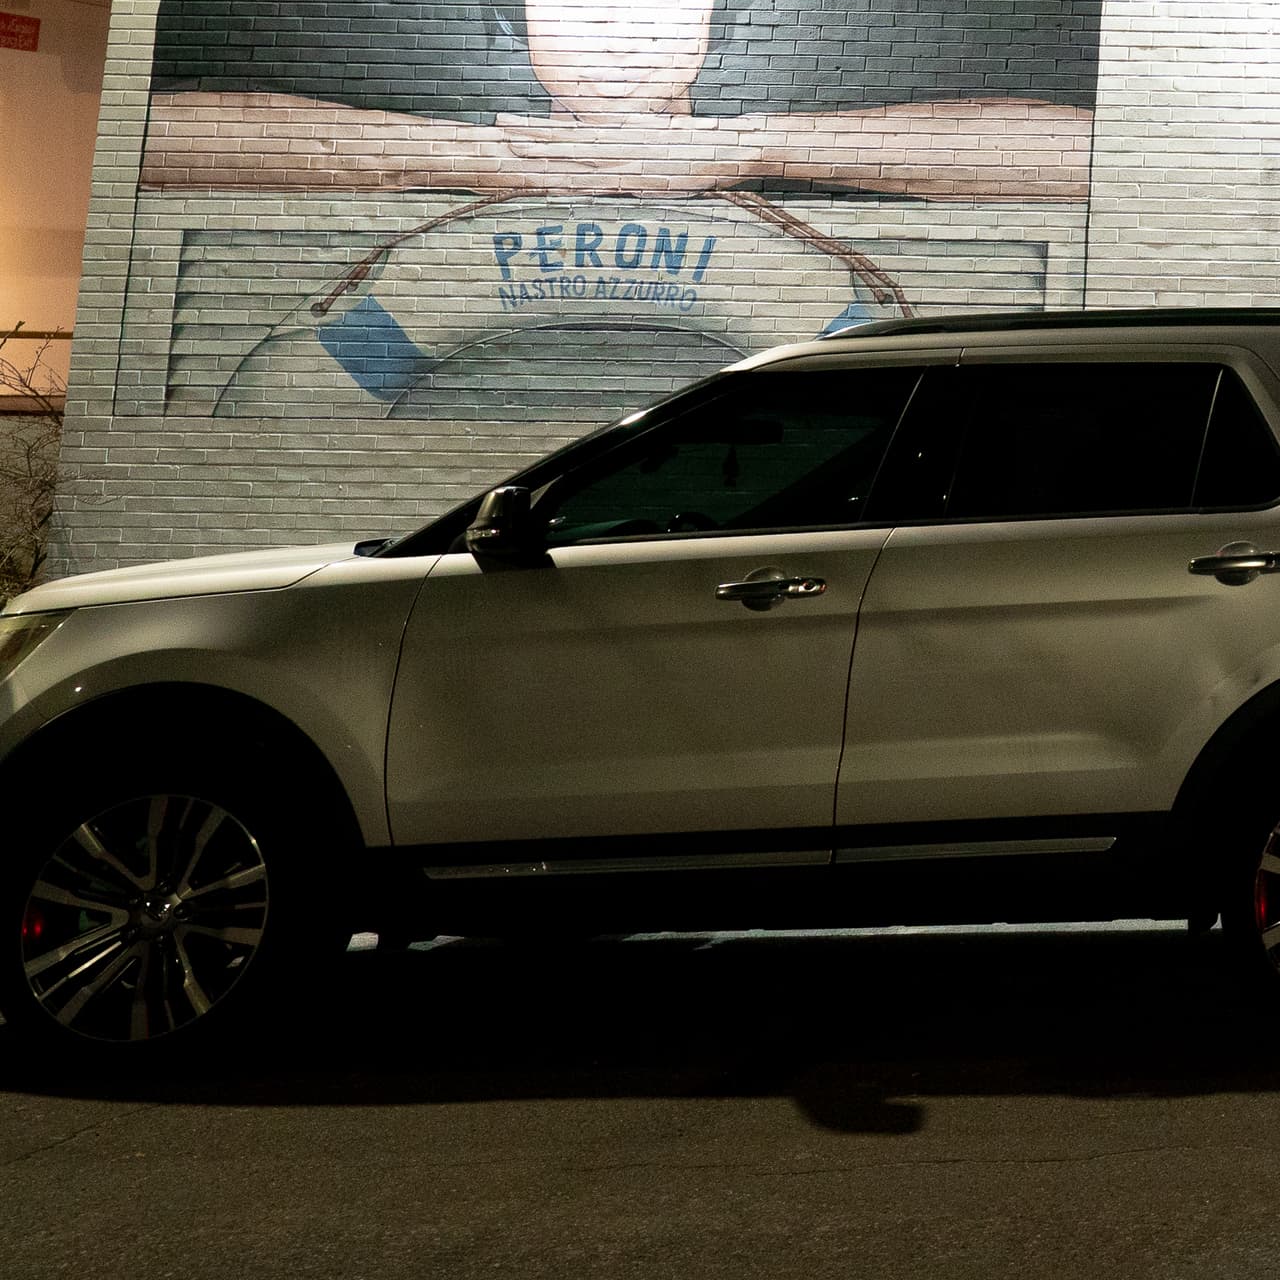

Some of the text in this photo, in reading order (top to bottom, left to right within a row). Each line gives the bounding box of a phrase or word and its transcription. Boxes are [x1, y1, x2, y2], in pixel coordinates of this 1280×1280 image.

[492, 222, 717, 284] PERONI
[497, 274, 698, 312] NASTRO AZZURRO
